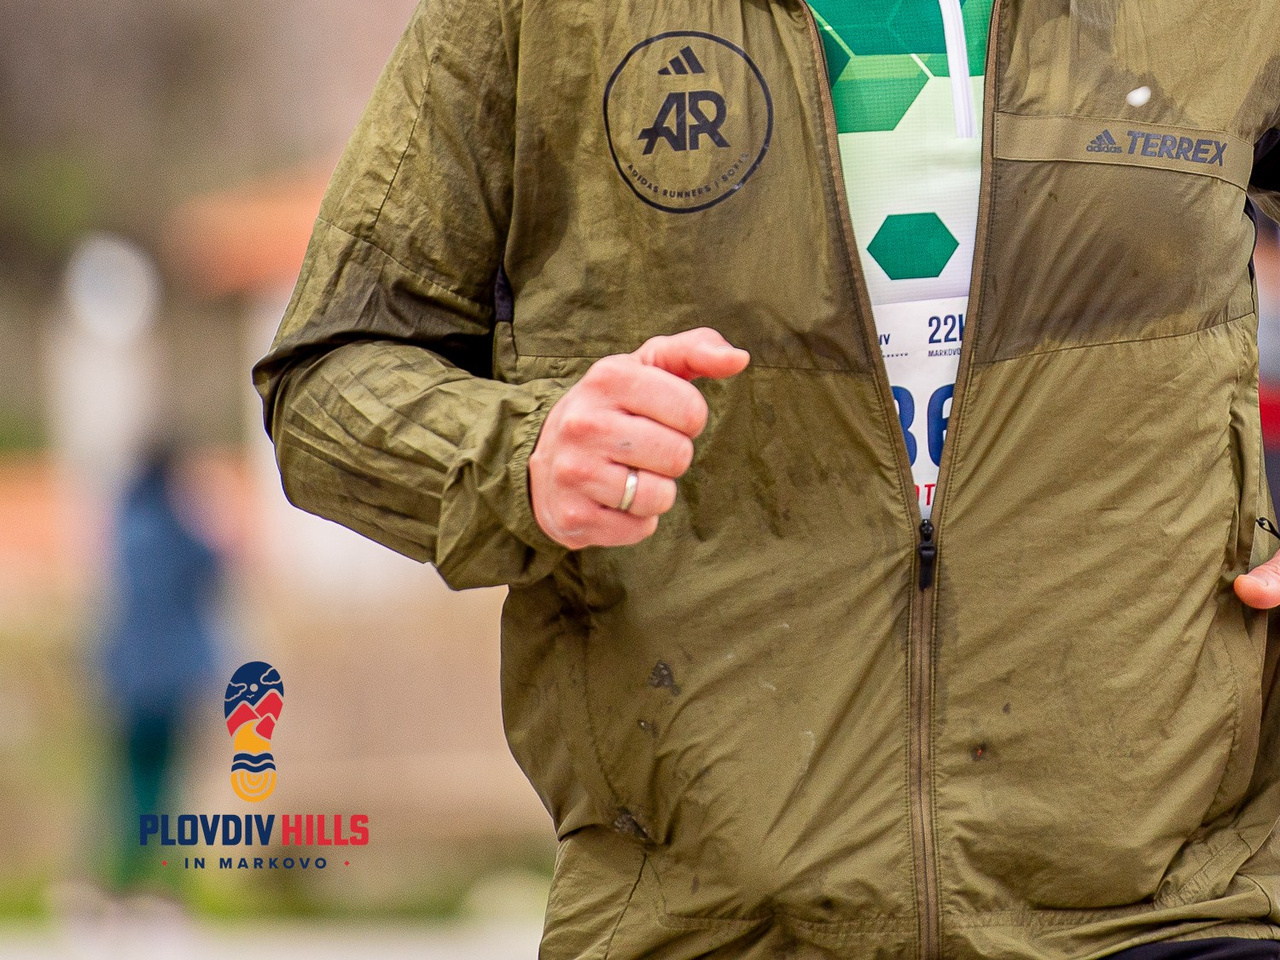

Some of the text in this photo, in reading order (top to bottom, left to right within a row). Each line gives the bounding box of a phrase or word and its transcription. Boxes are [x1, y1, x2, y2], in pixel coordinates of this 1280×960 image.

[637, 90, 731, 156] AR
[1086, 144, 1122, 153] adidas
[1127, 130, 1228, 167] TERREX
[627, 163, 660, 194] ADIDAS
[662, 184, 712, 199] RUNNERS
